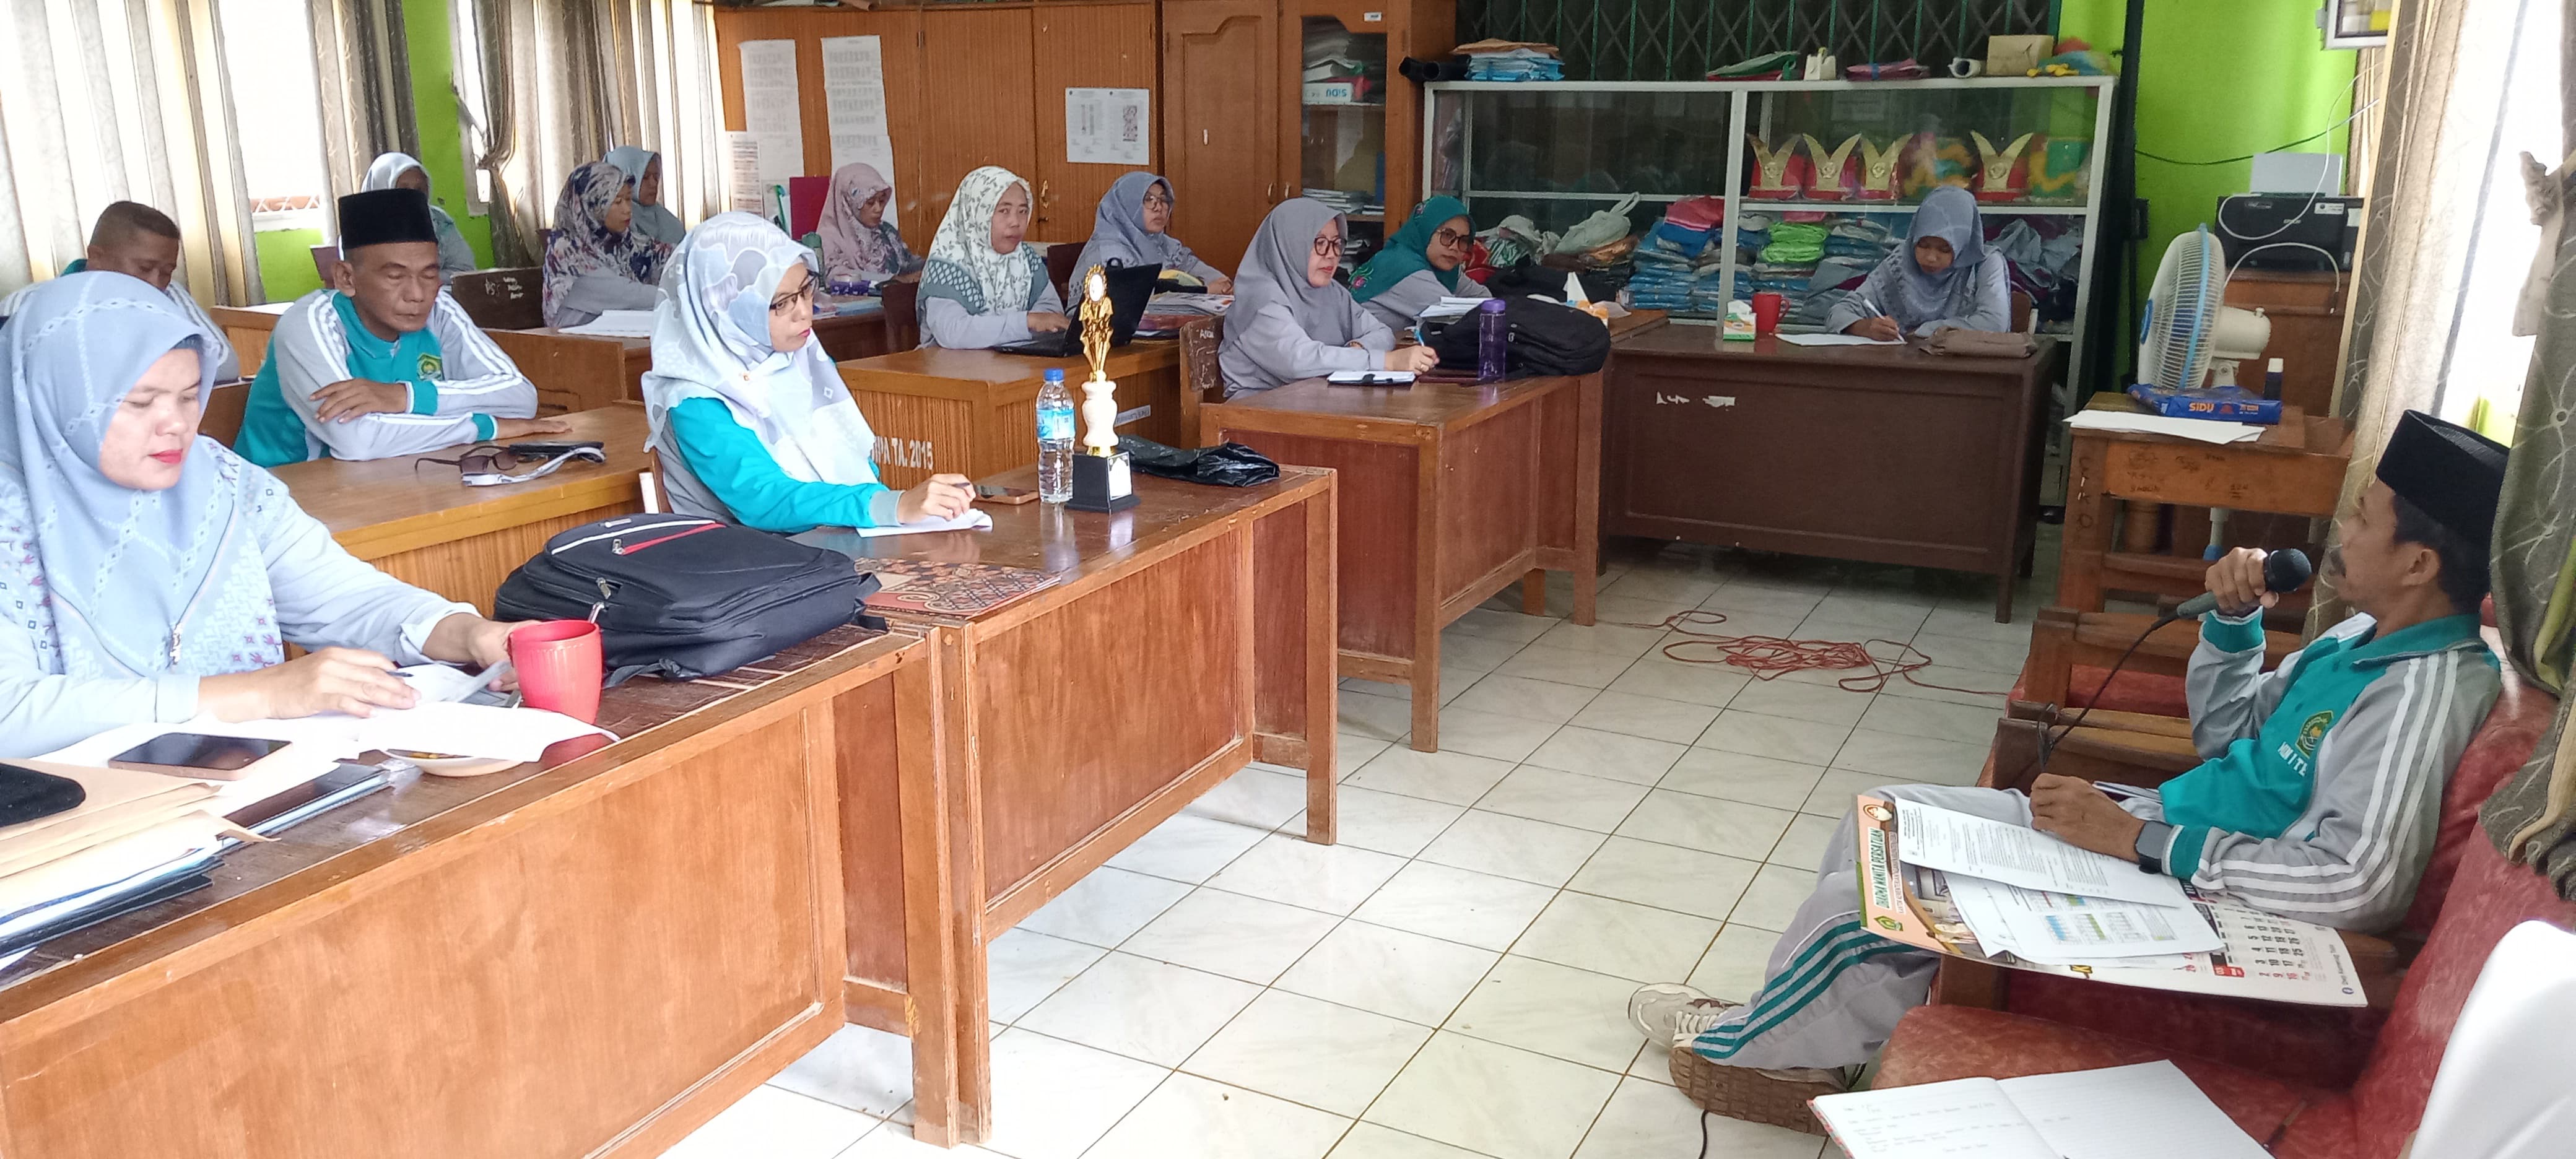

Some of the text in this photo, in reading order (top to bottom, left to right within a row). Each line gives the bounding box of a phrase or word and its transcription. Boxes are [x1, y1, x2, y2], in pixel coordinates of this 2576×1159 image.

[909, 439, 934, 471] 2015
[1869, 828, 1885, 862] PERSATUAN
[1871, 863, 1886, 886] WANITA
[2287, 937, 2300, 945] 26
[2292, 948, 2304, 957] 25
